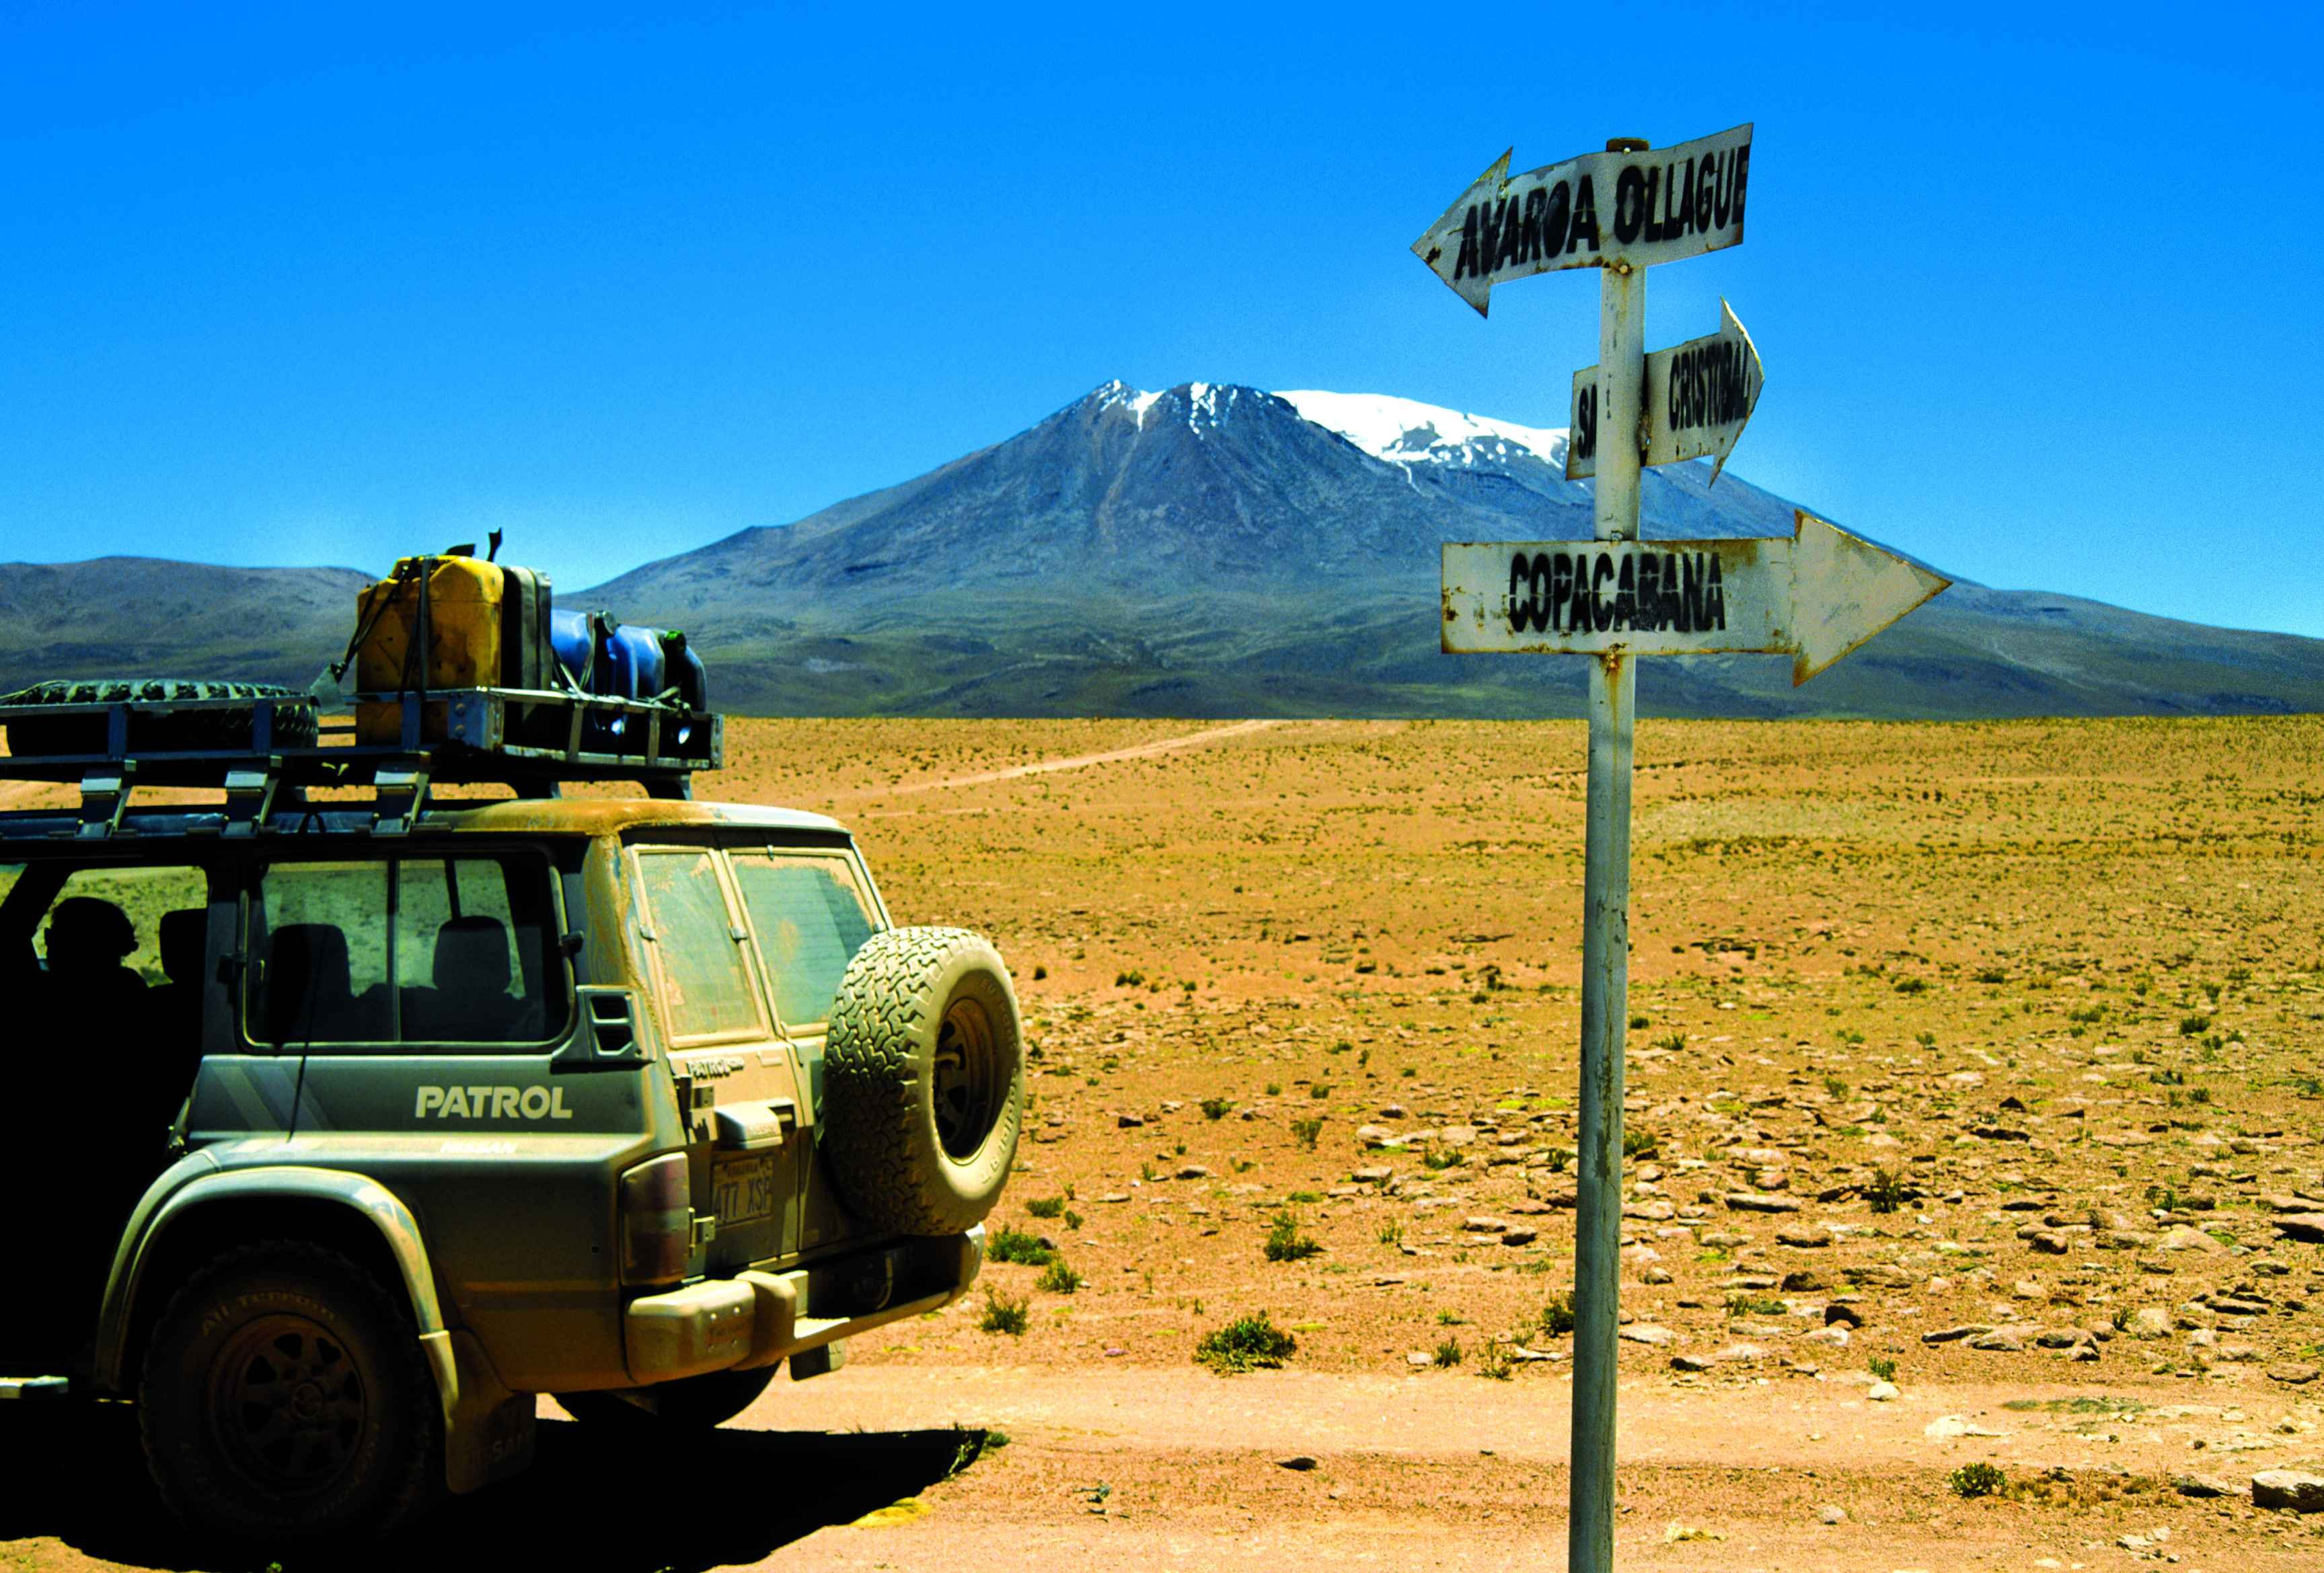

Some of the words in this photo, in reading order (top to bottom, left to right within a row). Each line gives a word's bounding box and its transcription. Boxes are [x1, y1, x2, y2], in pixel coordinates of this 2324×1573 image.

[1454, 174, 1600, 280] AVAROA
[1614, 143, 1750, 245] OLLAGUE
[1509, 552, 1726, 633] COPACABANA
[414, 1085, 573, 1119] PATROL
